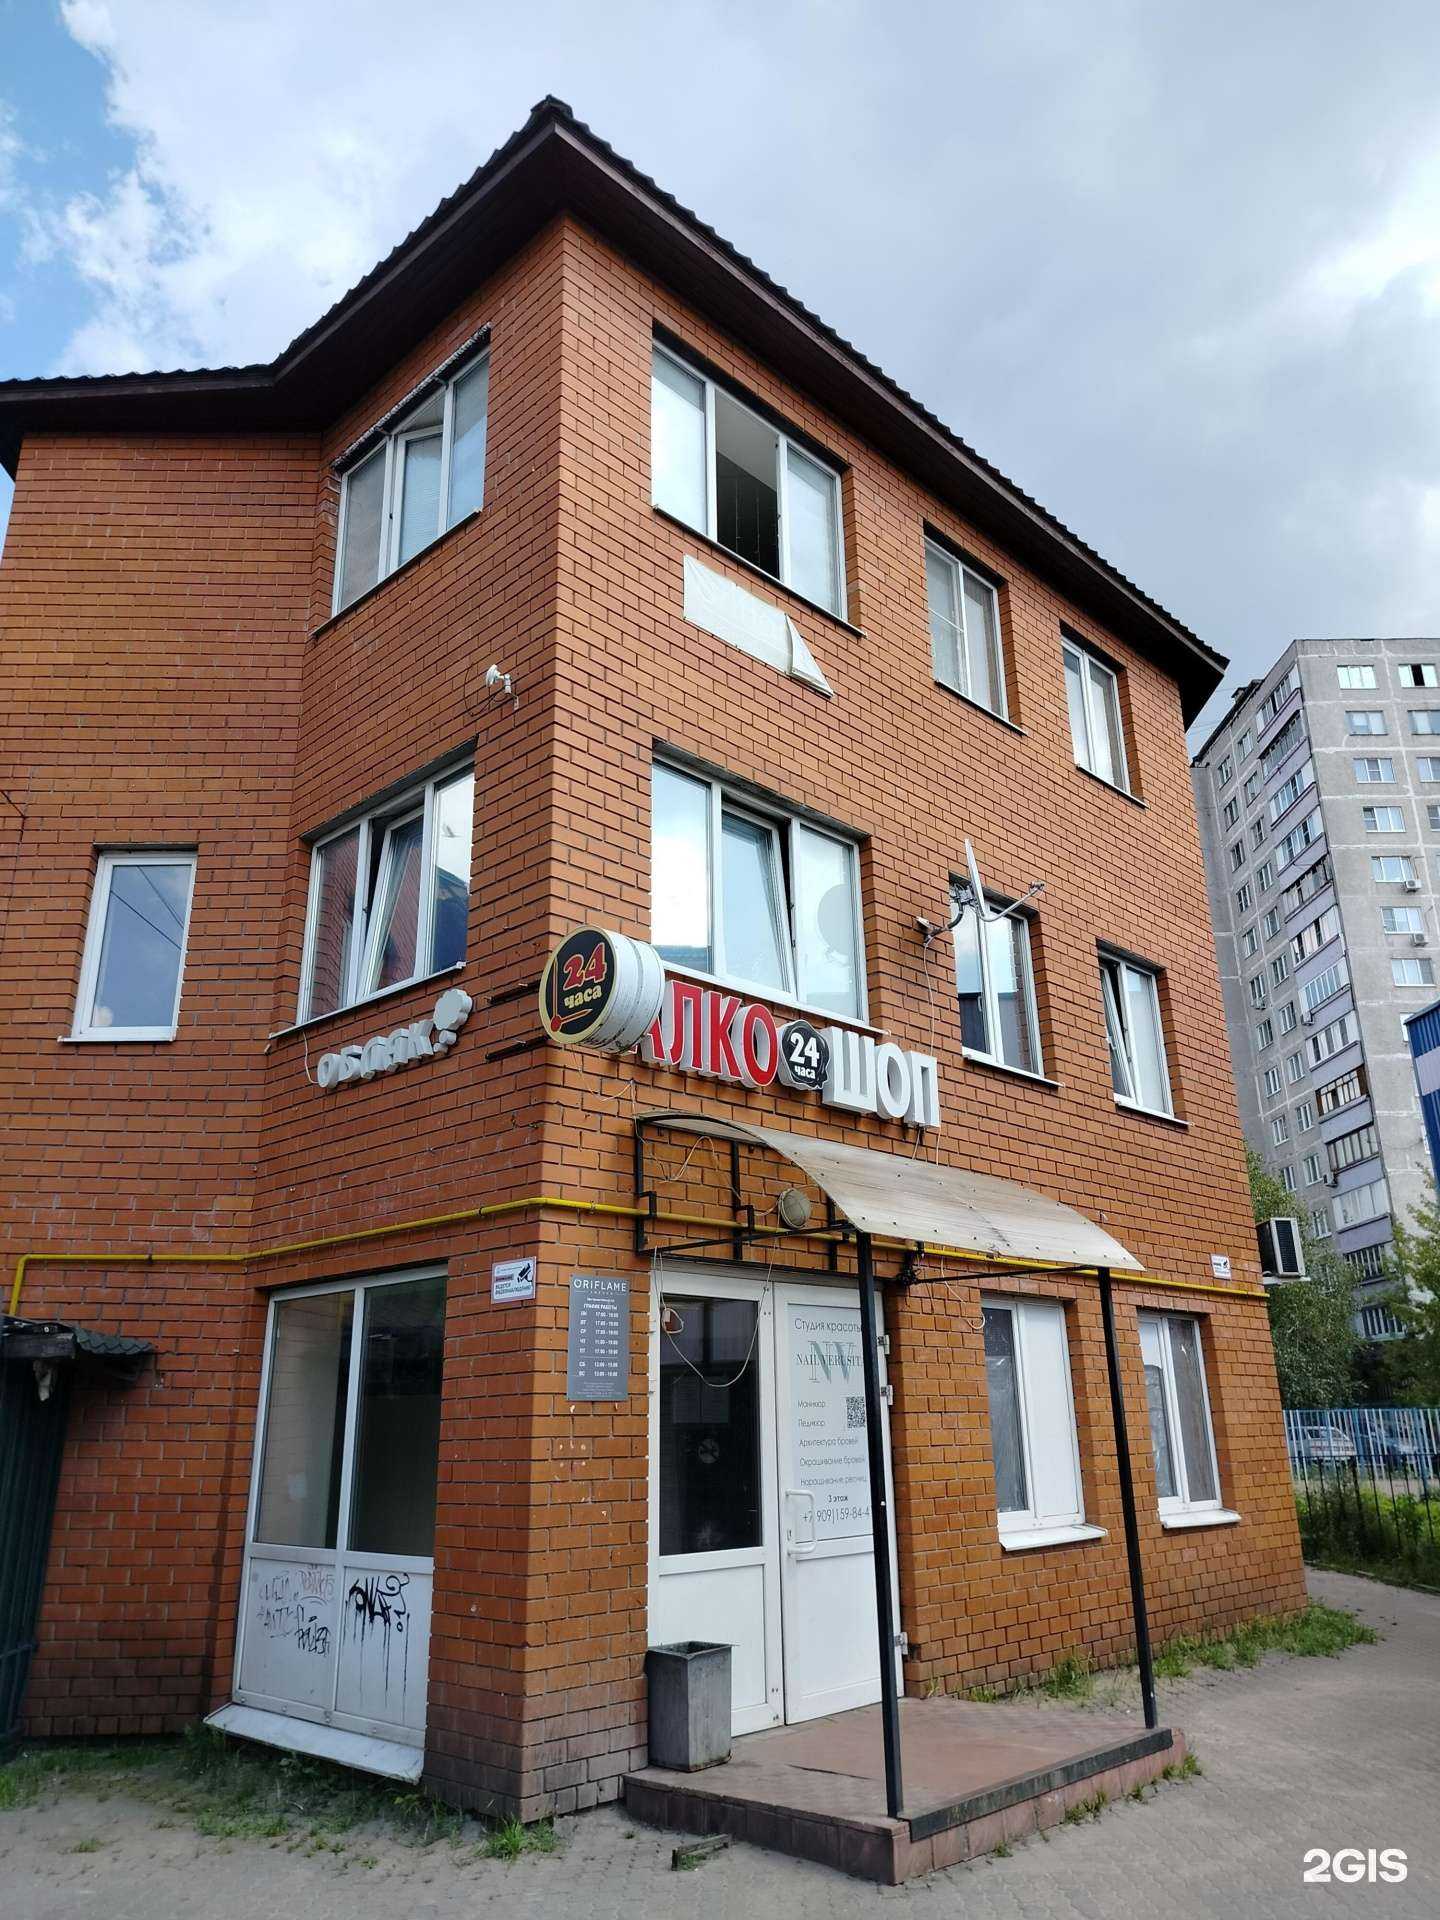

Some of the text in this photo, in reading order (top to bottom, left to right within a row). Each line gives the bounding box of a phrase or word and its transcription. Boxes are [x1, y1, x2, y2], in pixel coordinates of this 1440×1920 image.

[563, 942, 607, 990] 24
[564, 985, 602, 1009] часа
[789, 1032, 820, 1068] 24
[794, 1065, 816, 1079] часа
[823, 1025, 940, 1127] ШОП
[573, 1279, 627, 1292] ORIFLAME
[795, 1318, 824, 1332] Студия
[828, 1494, 832, 1503] 3
